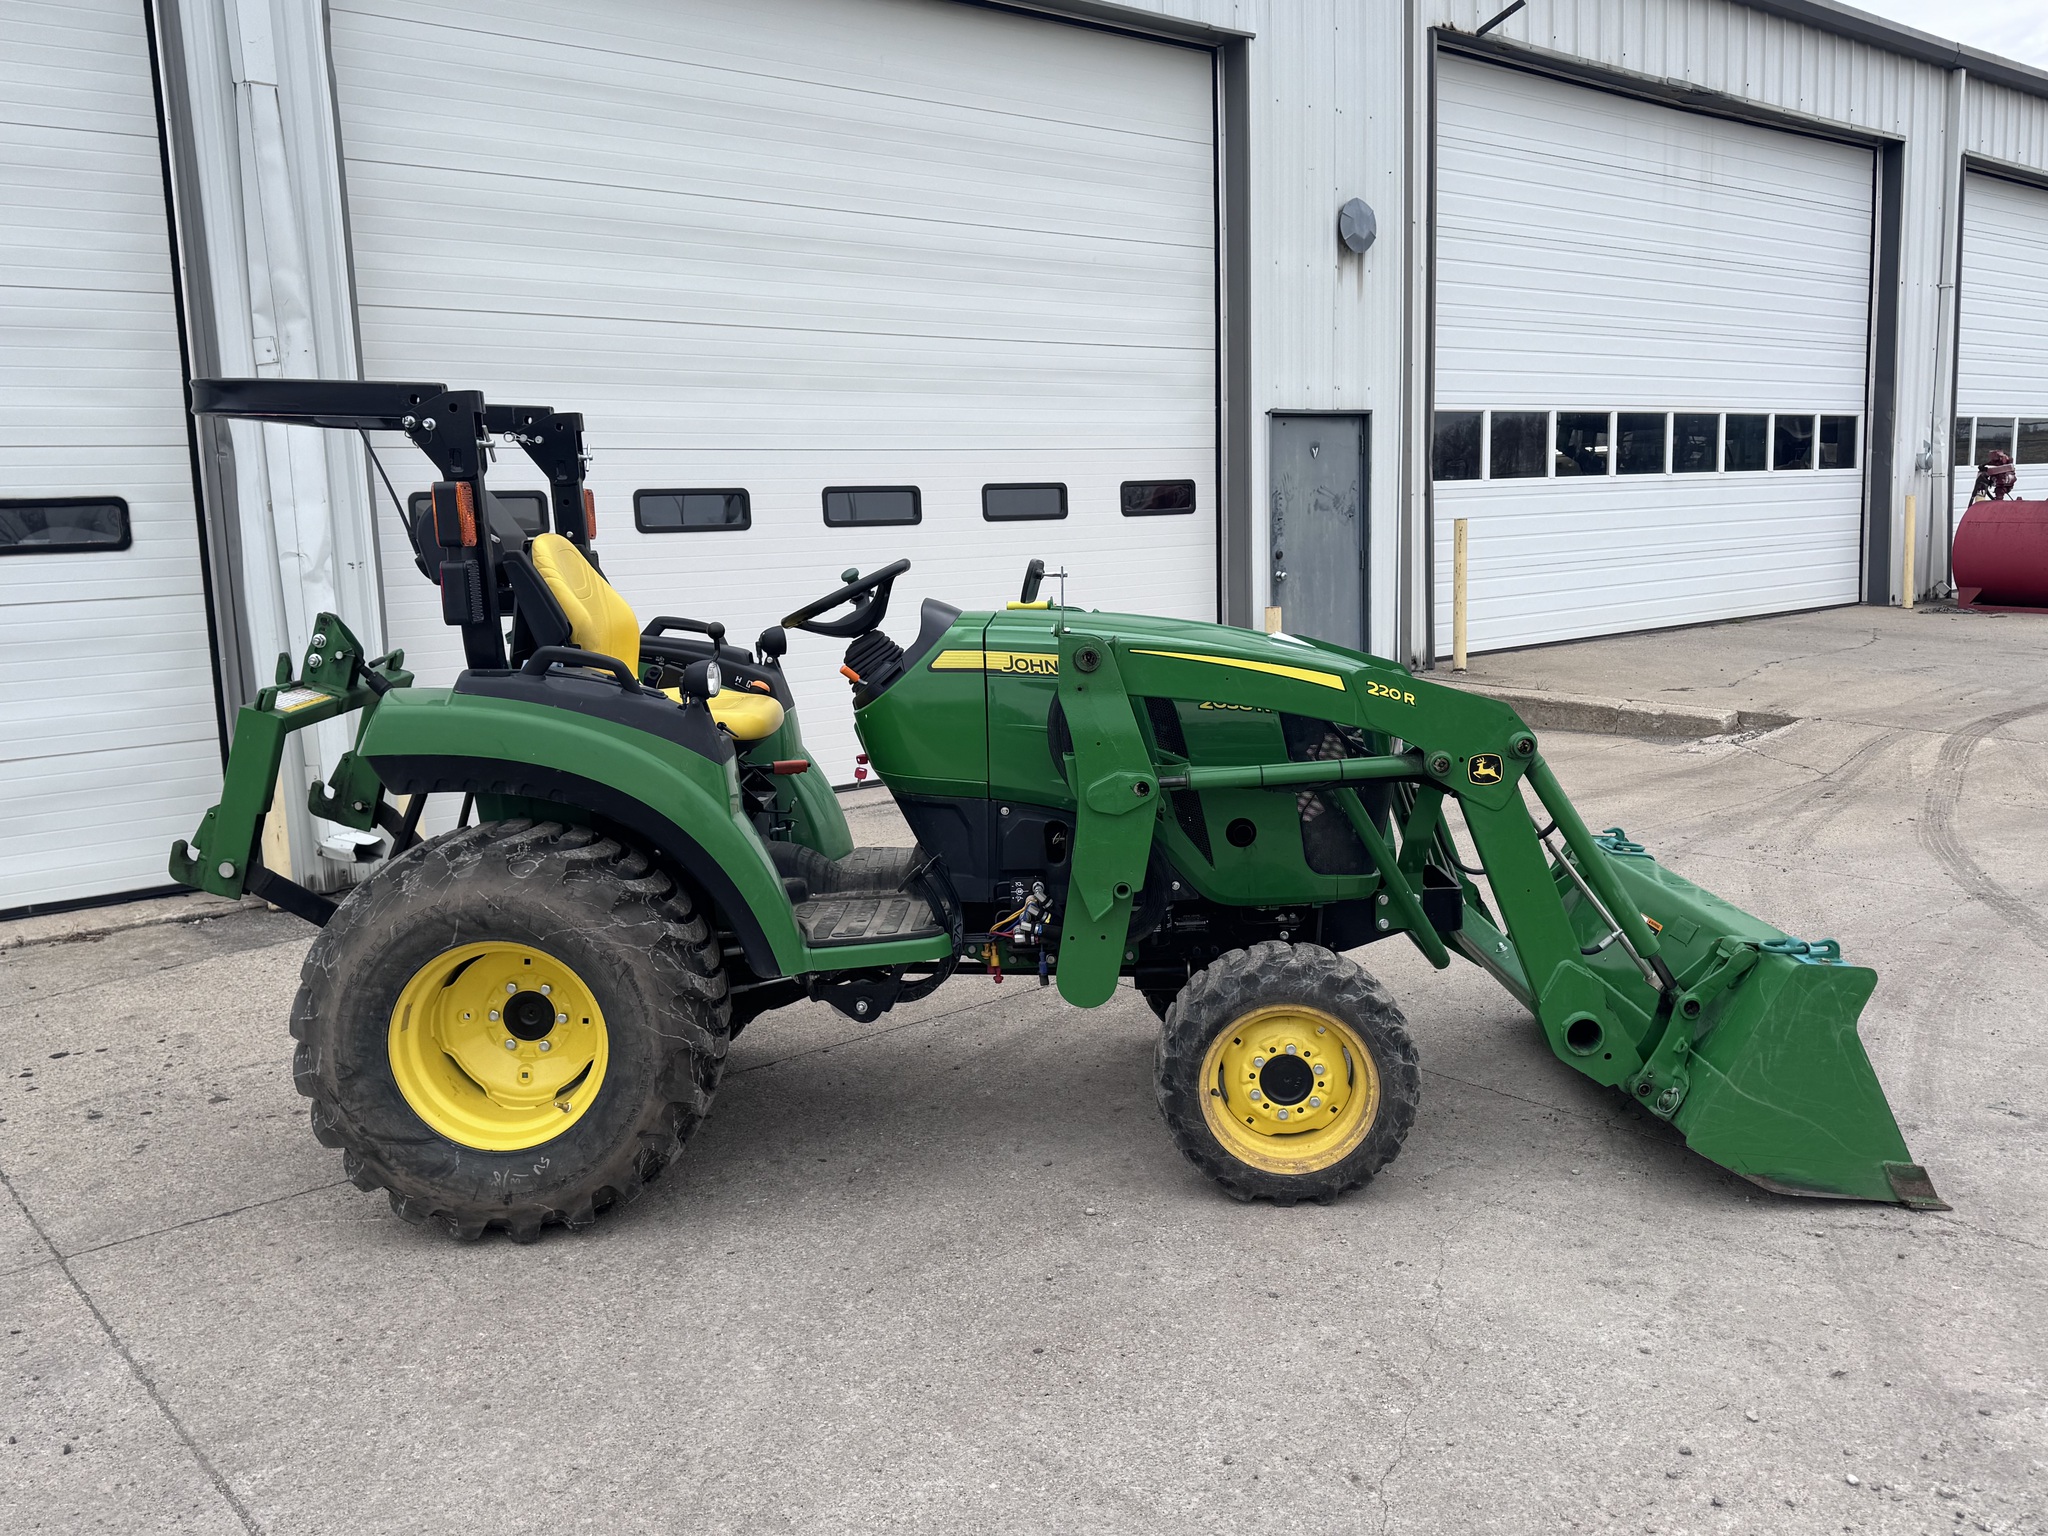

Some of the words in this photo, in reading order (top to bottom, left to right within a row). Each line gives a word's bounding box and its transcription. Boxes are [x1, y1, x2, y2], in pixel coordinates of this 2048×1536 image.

[1002, 654, 1058, 674] JOHN
[1366, 680, 1402, 701] 220
[1403, 691, 1416, 706] R
